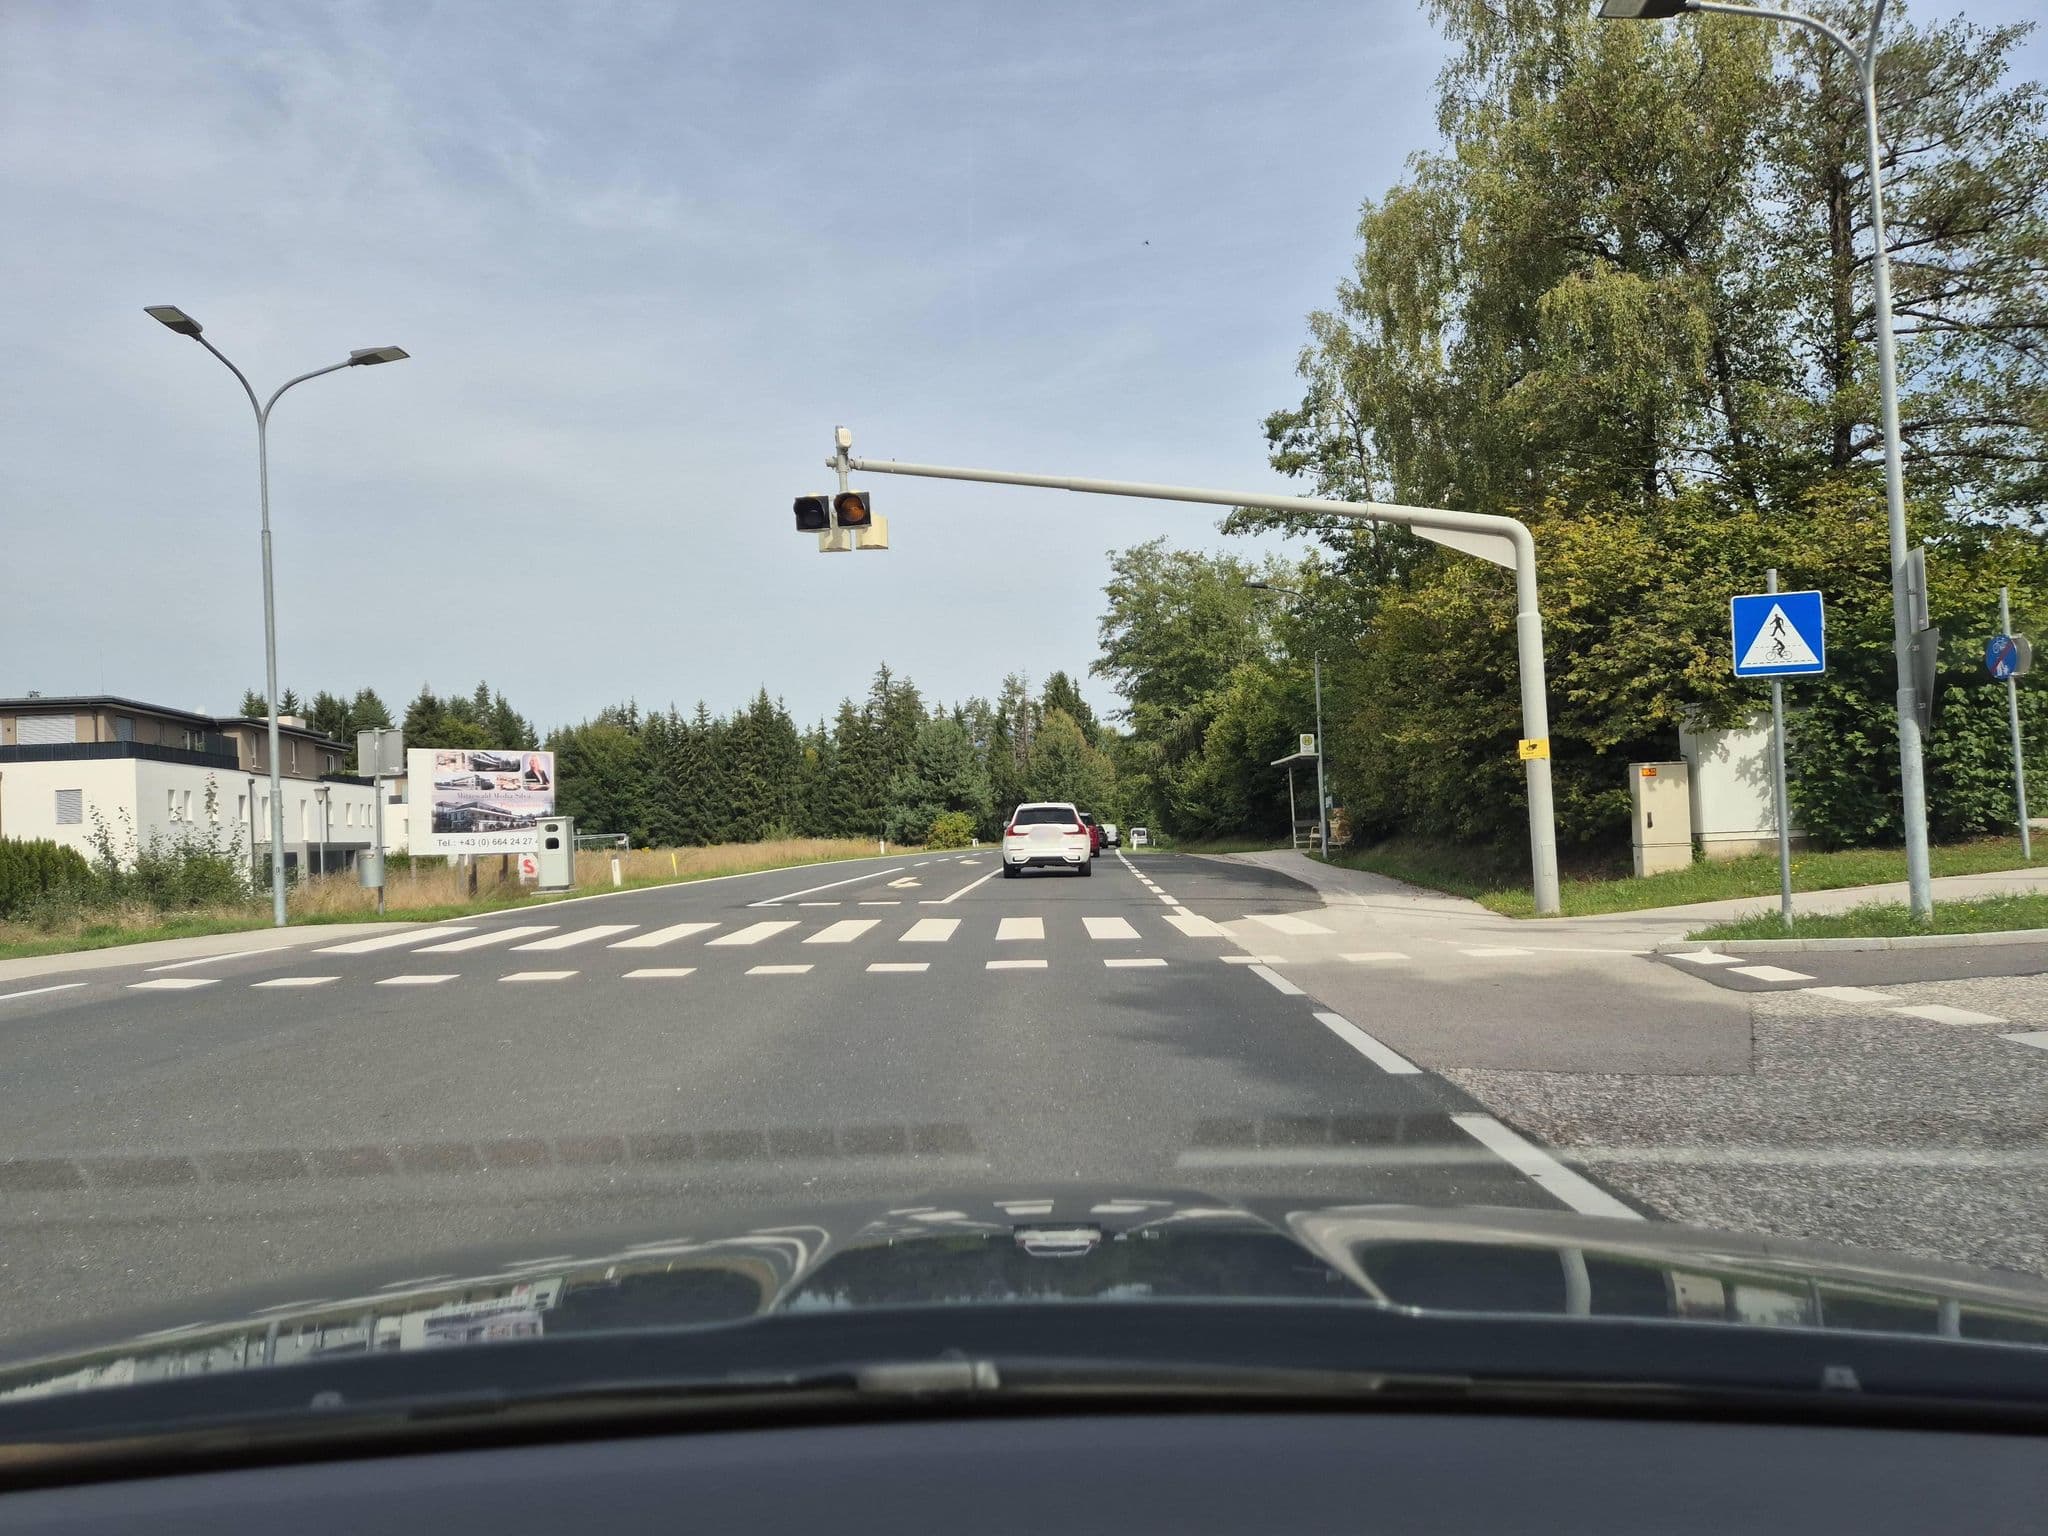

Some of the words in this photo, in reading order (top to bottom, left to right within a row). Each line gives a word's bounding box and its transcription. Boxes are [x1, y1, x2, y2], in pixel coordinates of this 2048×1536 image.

[460, 838, 475, 846] +43
[478, 838, 490, 848] (0)
[492, 838, 508, 846] 664
[510, 837, 521, 846] 24
[522, 837, 533, 845] 27
